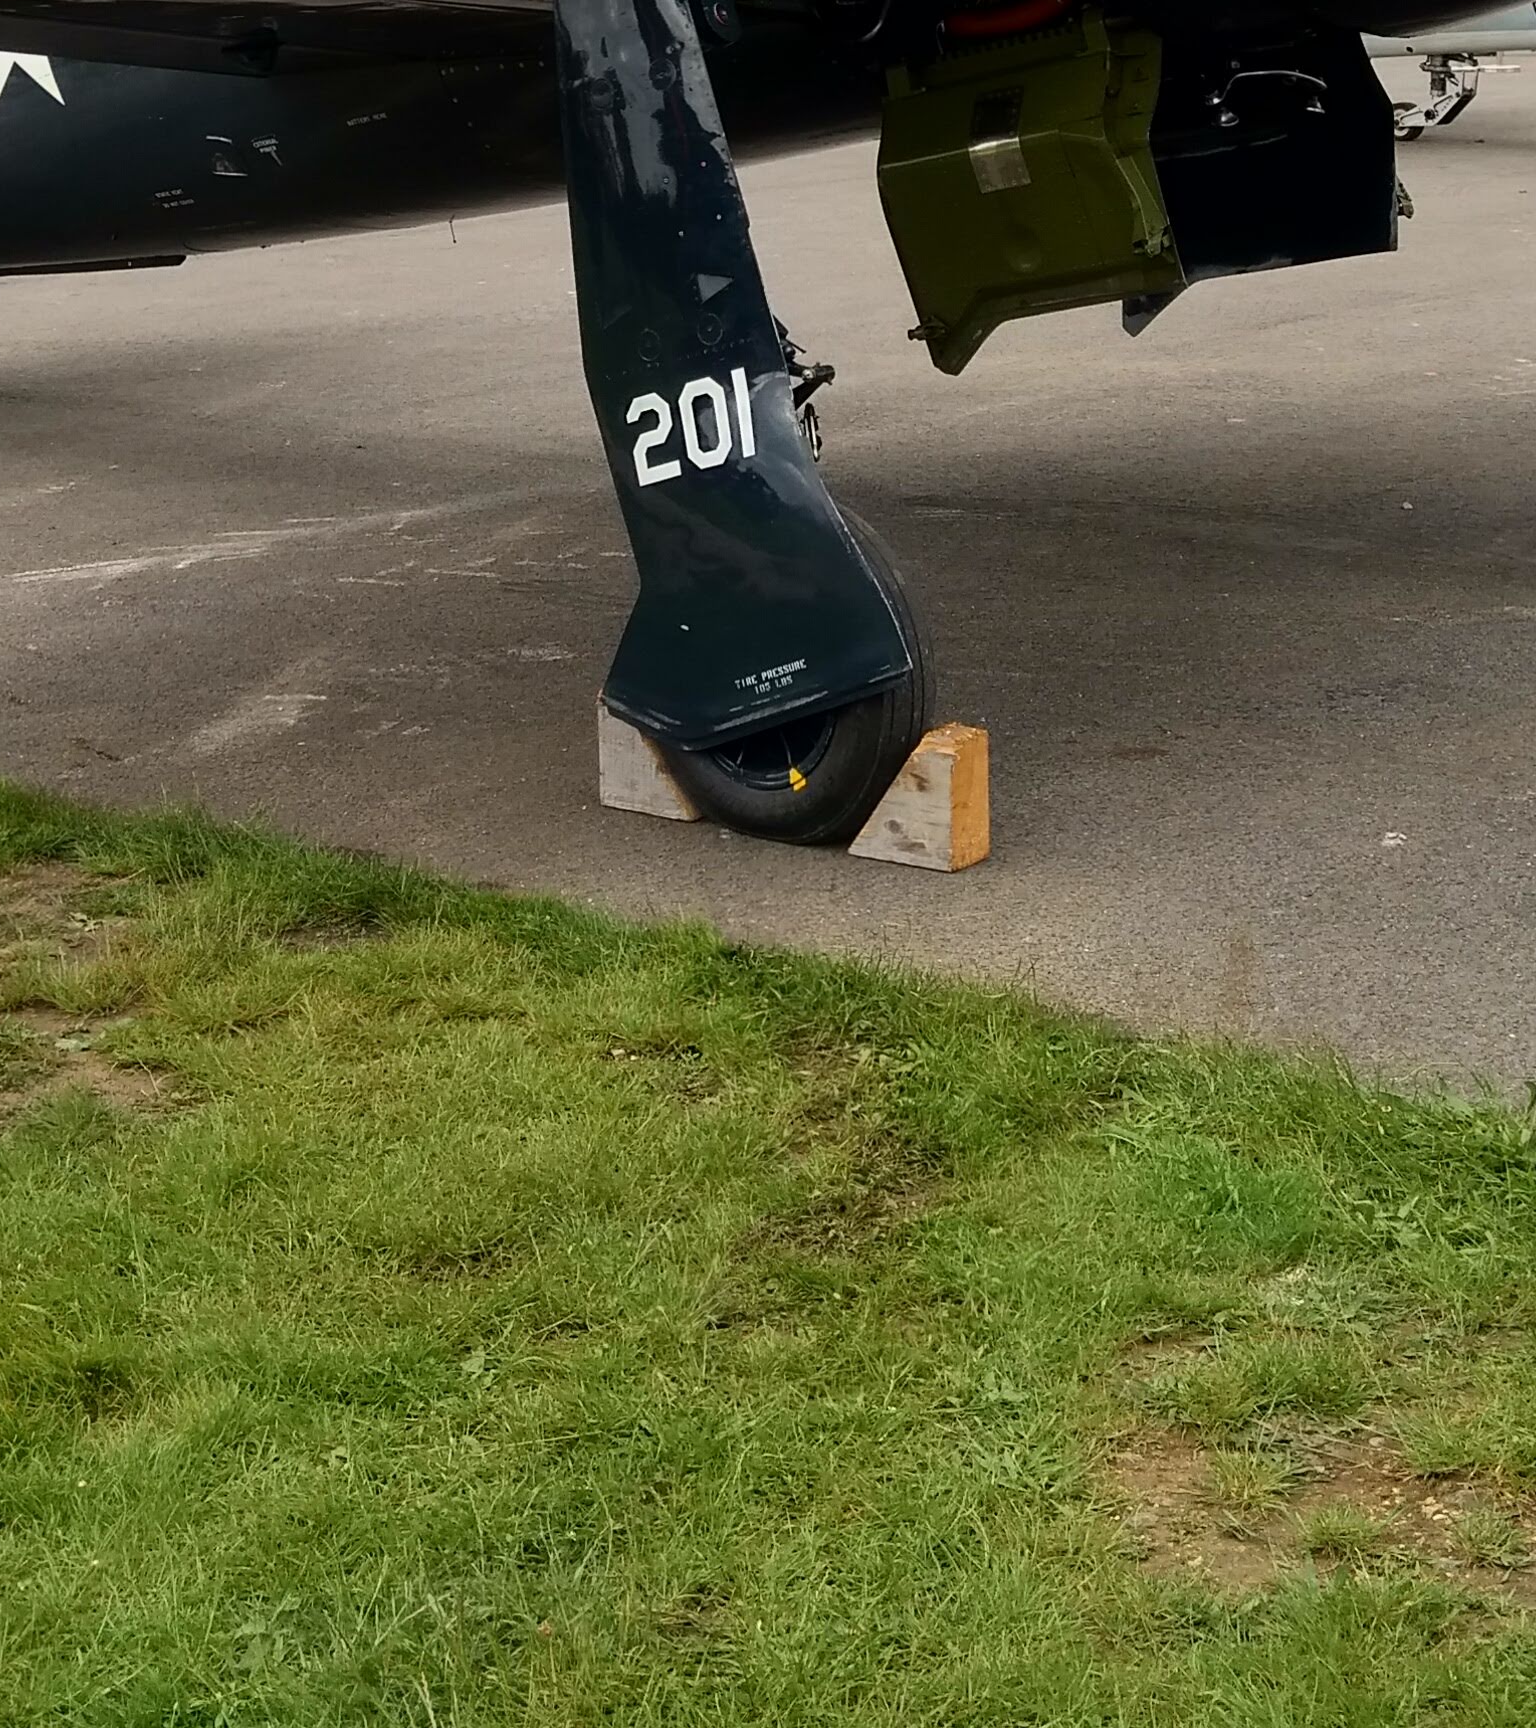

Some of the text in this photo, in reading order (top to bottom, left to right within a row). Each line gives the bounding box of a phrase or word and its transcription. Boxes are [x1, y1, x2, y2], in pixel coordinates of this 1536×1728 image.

[626, 367, 758, 487] 201
[735, 658, 807, 690] TIRE PRESSURE
